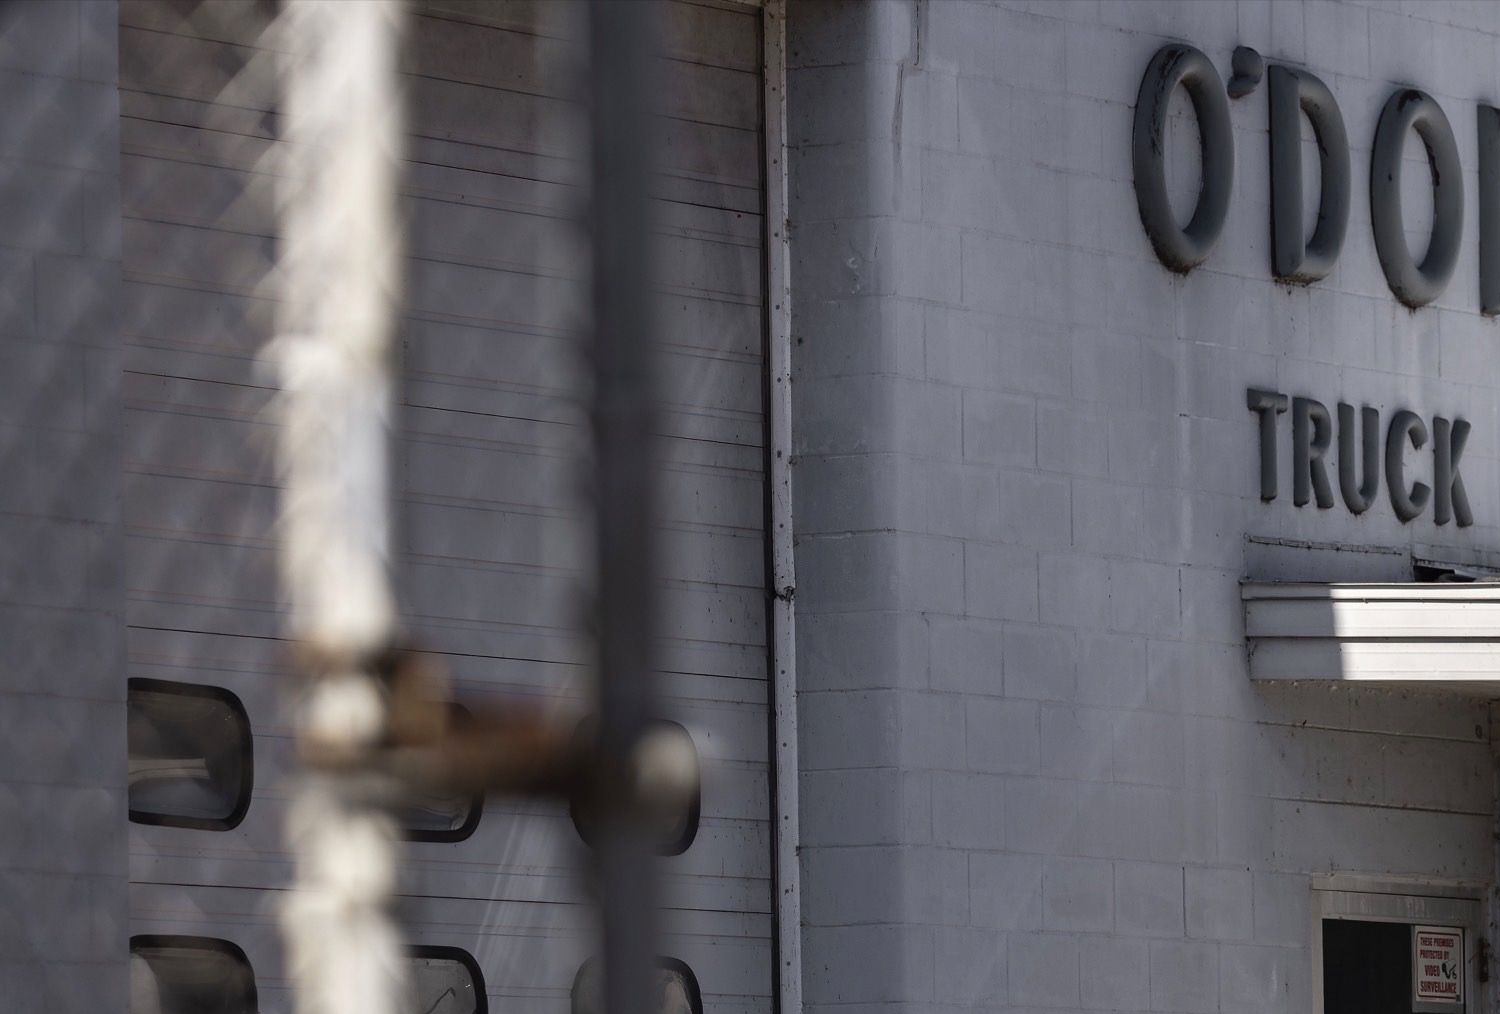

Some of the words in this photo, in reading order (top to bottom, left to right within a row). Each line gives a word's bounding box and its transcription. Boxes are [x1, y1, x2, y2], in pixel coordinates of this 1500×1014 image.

[1247, 388, 1473, 528] TRUCK
[1424, 964, 1441, 977] VIDEO
[1420, 980, 1456, 993] SURVEILLANCE
